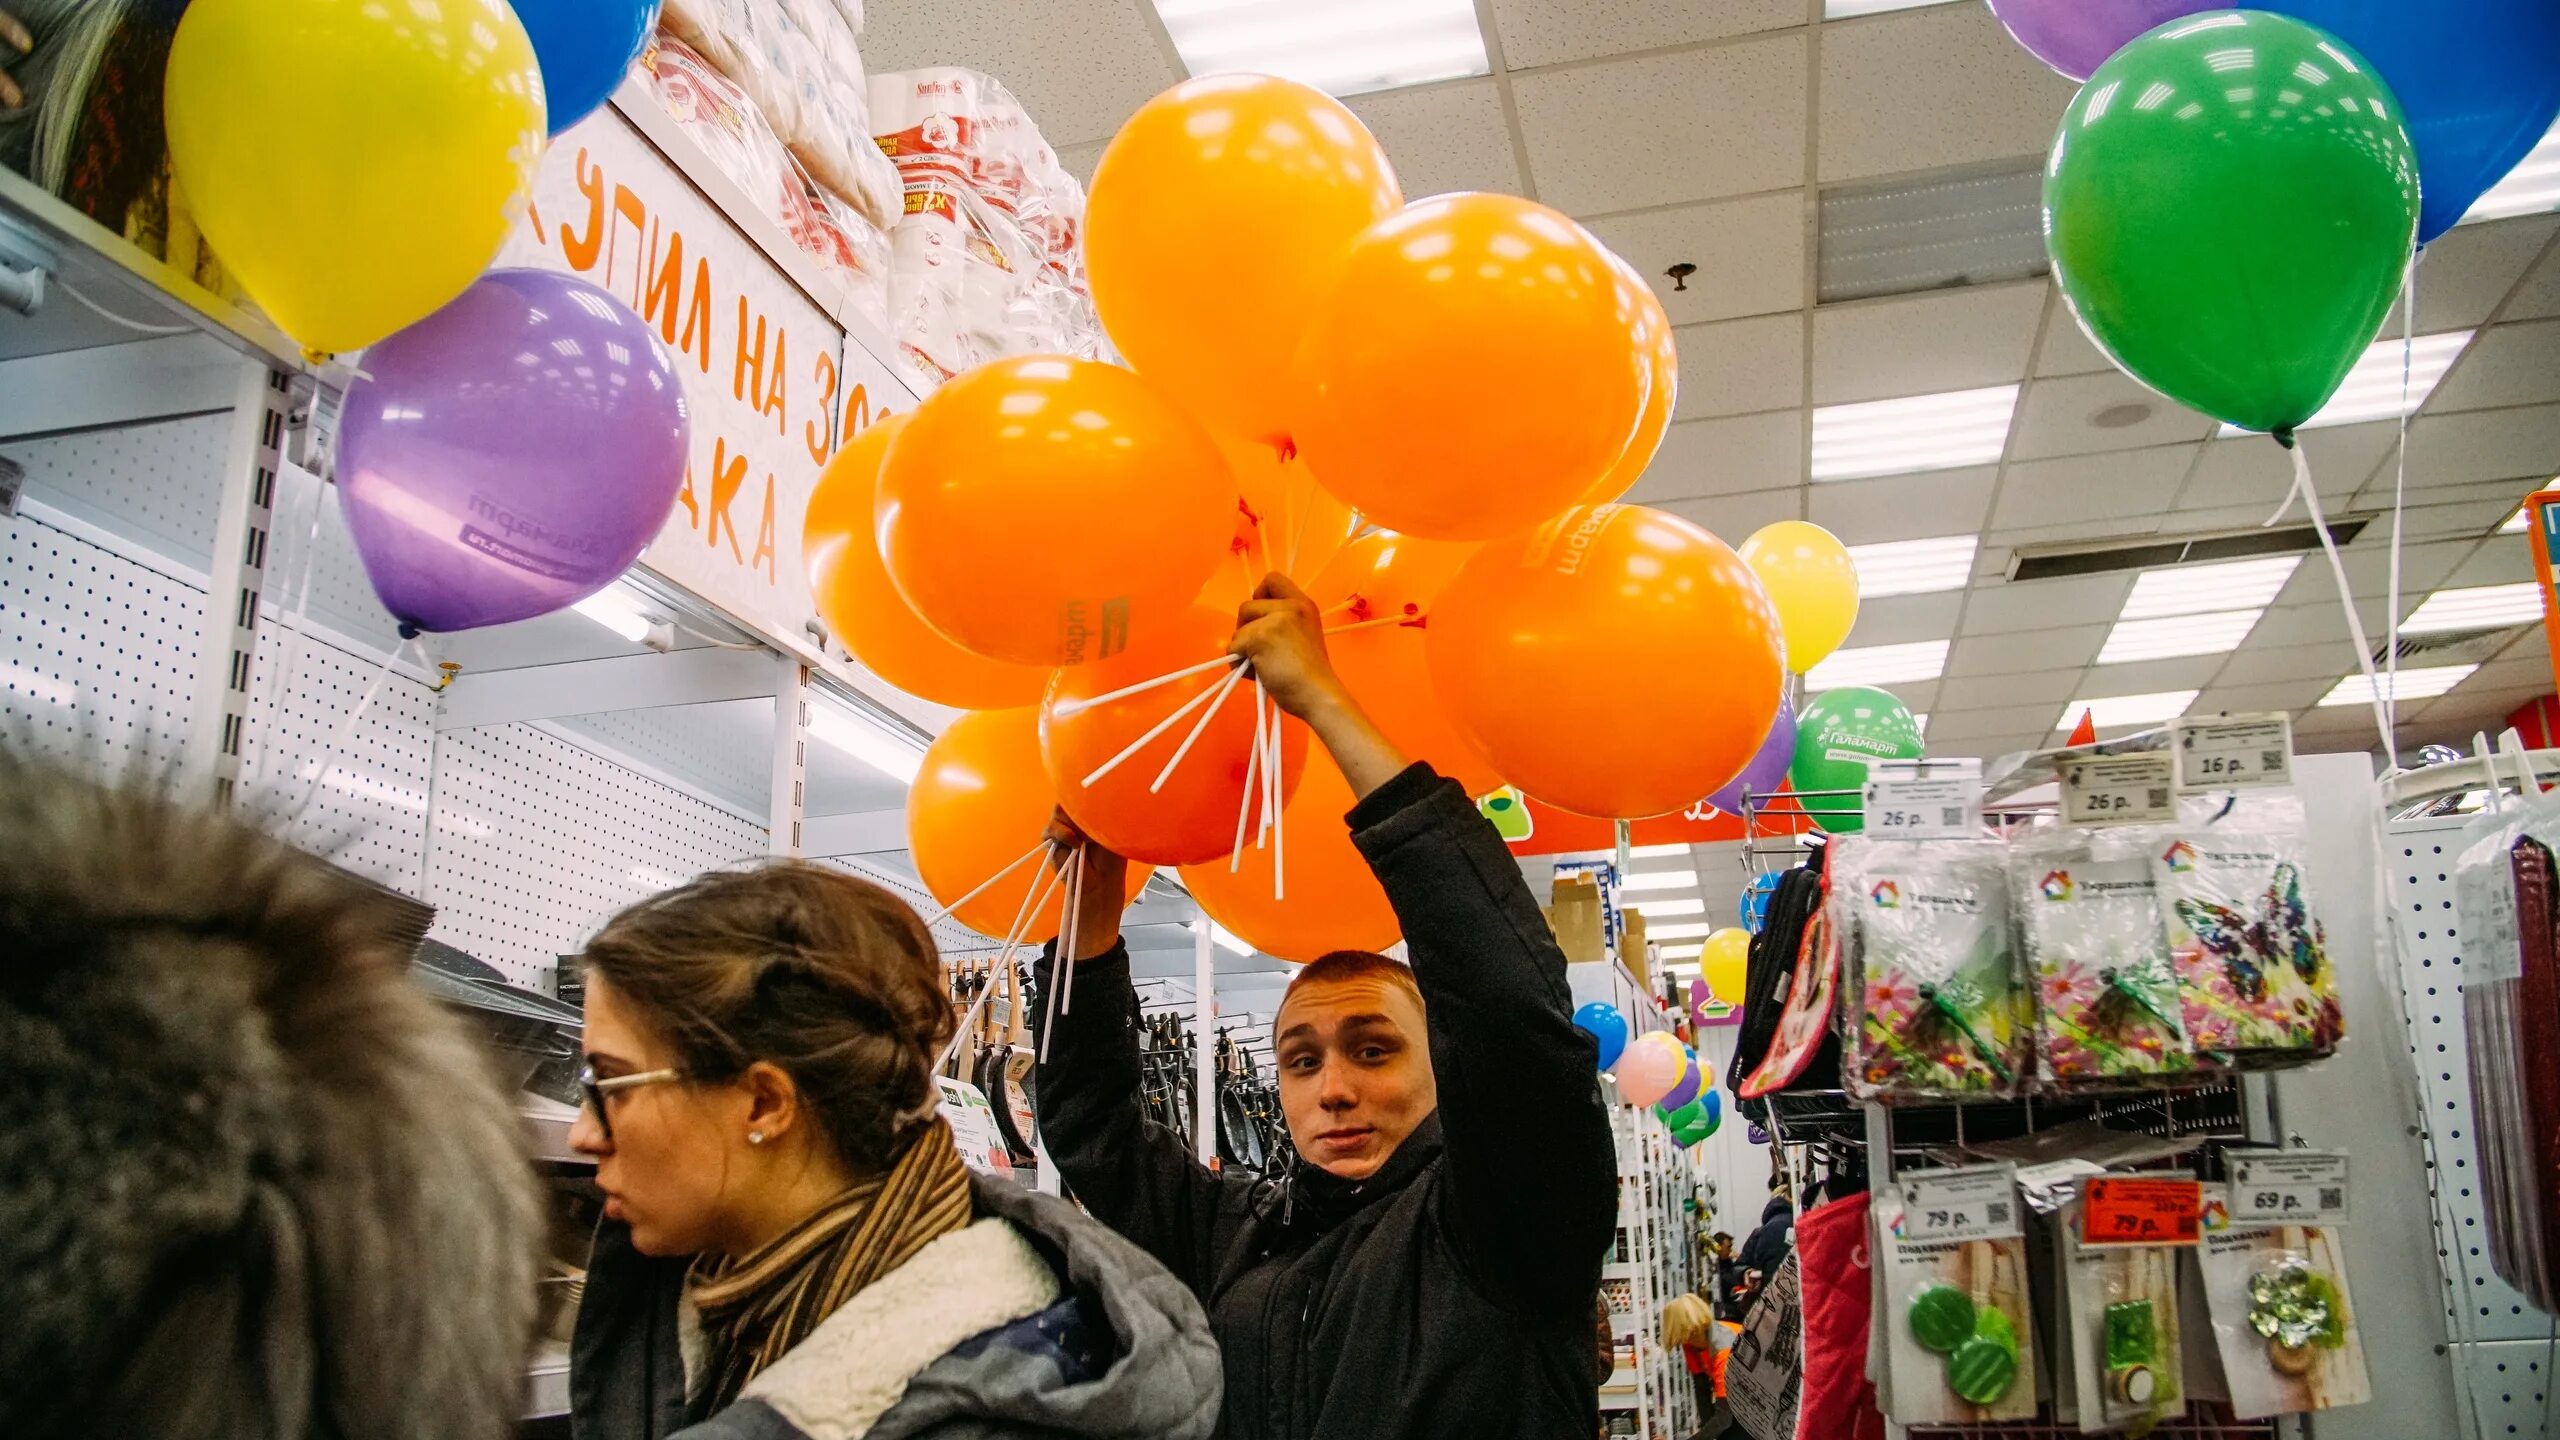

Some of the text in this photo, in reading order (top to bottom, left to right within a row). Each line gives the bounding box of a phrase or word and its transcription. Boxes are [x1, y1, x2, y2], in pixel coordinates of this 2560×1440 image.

[734, 295, 787, 436] НА
[805, 351, 892, 468] 30
[1829, 732, 1898, 757] Галамарт
[2201, 757, 2224, 773] 16
[2087, 794, 2109, 810] 26
[1883, 811, 1905, 826] 26
[2254, 1191, 2279, 1209] 69
[1927, 1211, 1949, 1228] 79
[2114, 1214, 2138, 1232] 79
